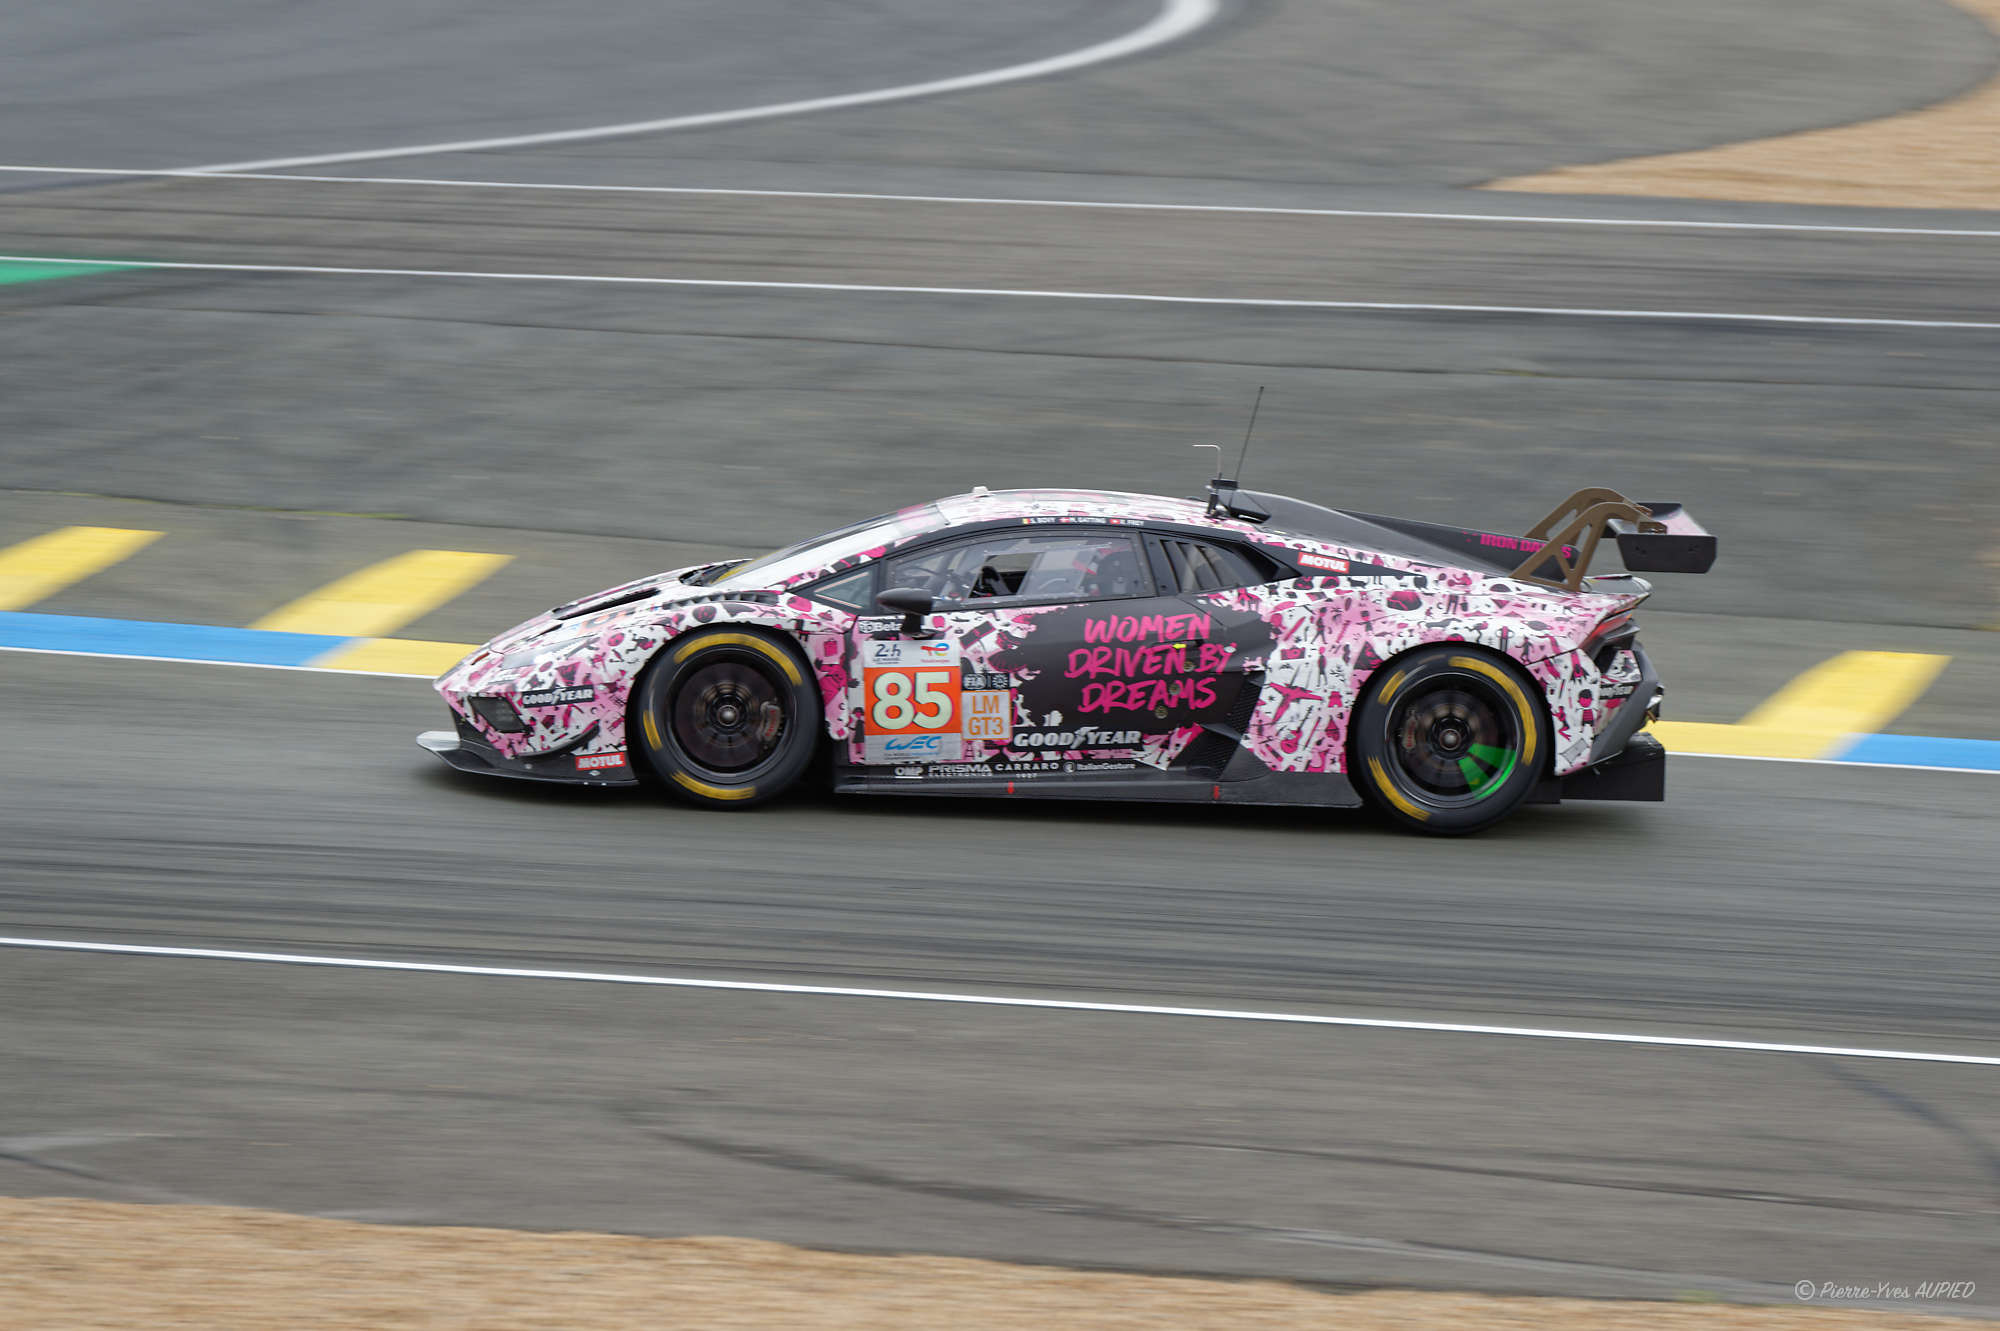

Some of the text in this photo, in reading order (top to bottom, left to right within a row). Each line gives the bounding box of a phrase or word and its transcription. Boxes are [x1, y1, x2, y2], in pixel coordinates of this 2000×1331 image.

[1480, 533, 1572, 559] IRON DAS
[1300, 554, 1347, 572] MOTUL
[1084, 611, 1213, 643] WOMEN
[1064, 642, 1238, 679] DRIVEN BY
[523, 688, 594, 705] GOODYEAR
[873, 672, 953, 730] 85
[972, 695, 1000, 714] LM
[1077, 677, 1217, 714] DREAMS
[968, 717, 1003, 736] GT3
[884, 736, 943, 751] WEC
[1013, 726, 1142, 749] GOODYEAR
[578, 755, 623, 768] MOTUL
[928, 764, 992, 773] PRISMA
[995, 763, 1060, 771] CARRARO
